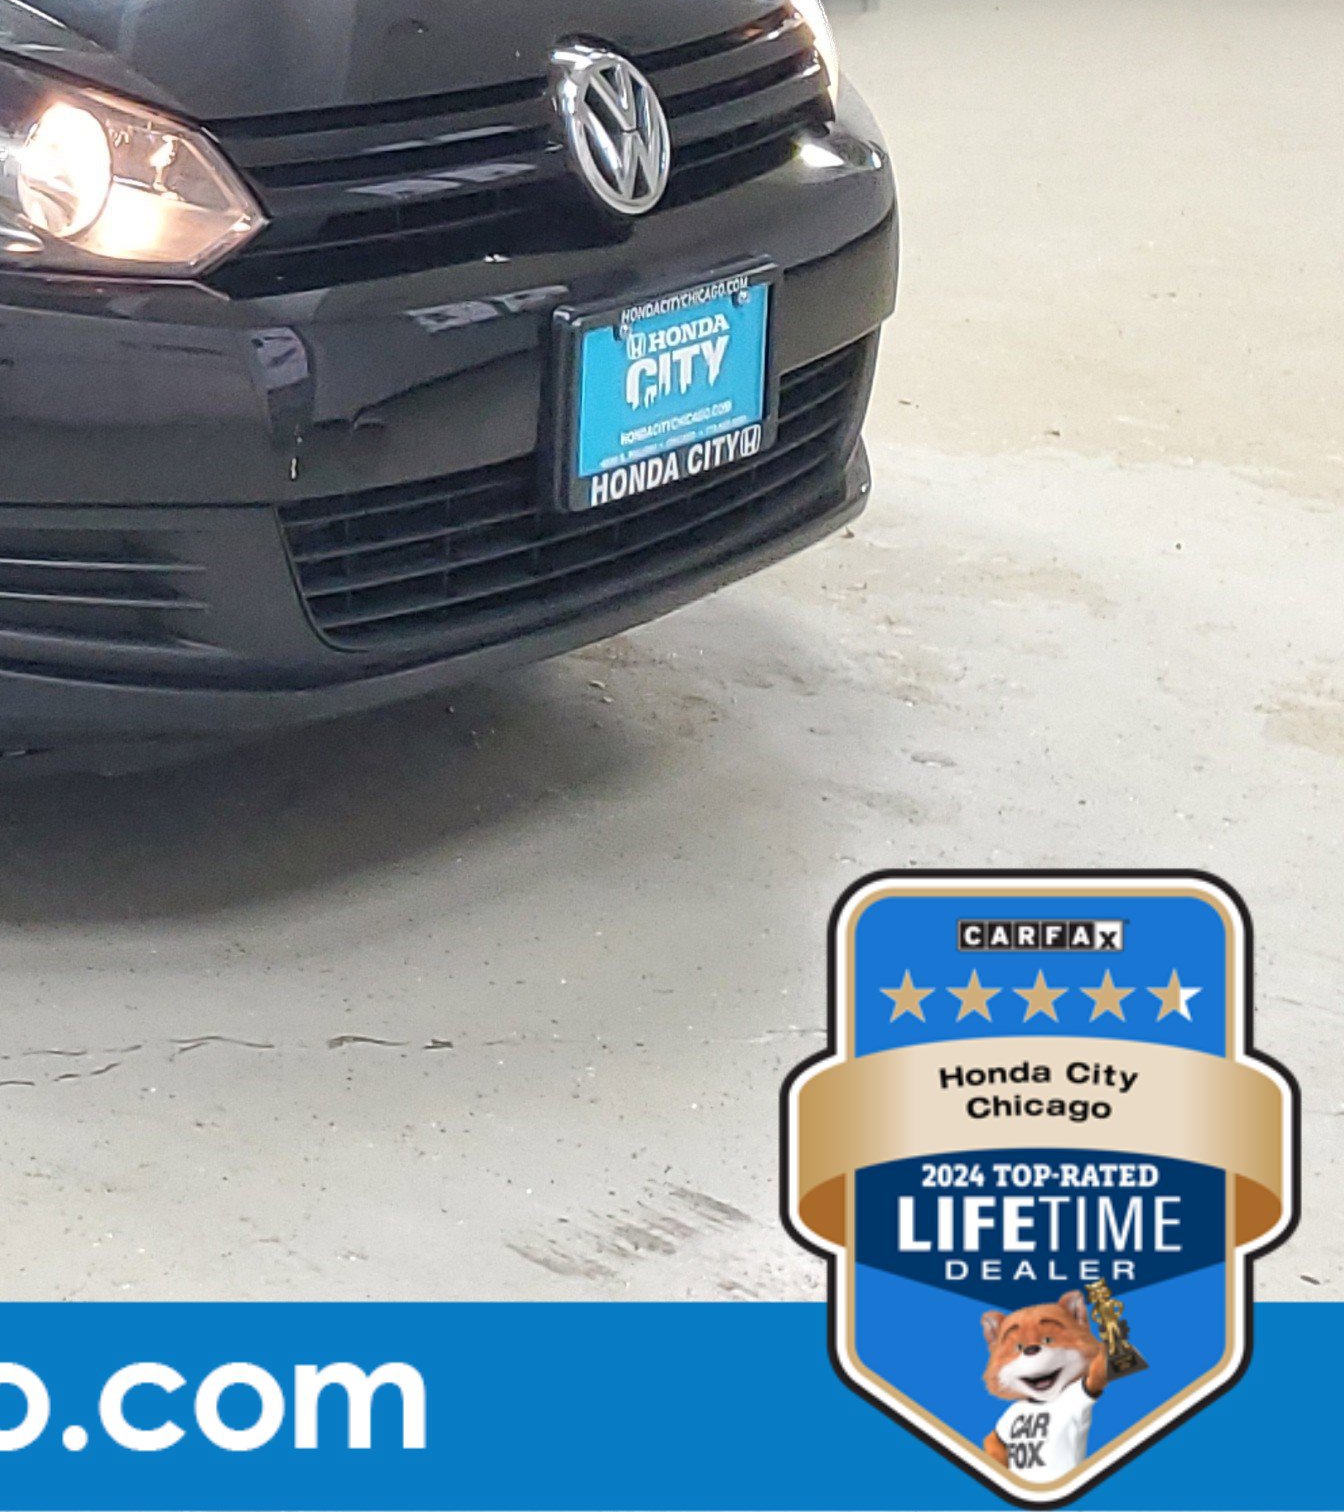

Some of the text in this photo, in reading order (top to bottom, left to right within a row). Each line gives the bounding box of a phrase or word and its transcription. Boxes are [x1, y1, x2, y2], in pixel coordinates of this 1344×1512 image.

[621, 275, 749, 325] HONDACITYCHICAGO.COM
[648, 313, 731, 353] HONDA
[625, 334, 730, 410] CITY
[591, 451, 679, 507] HONDA
[686, 429, 741, 476] CITY
